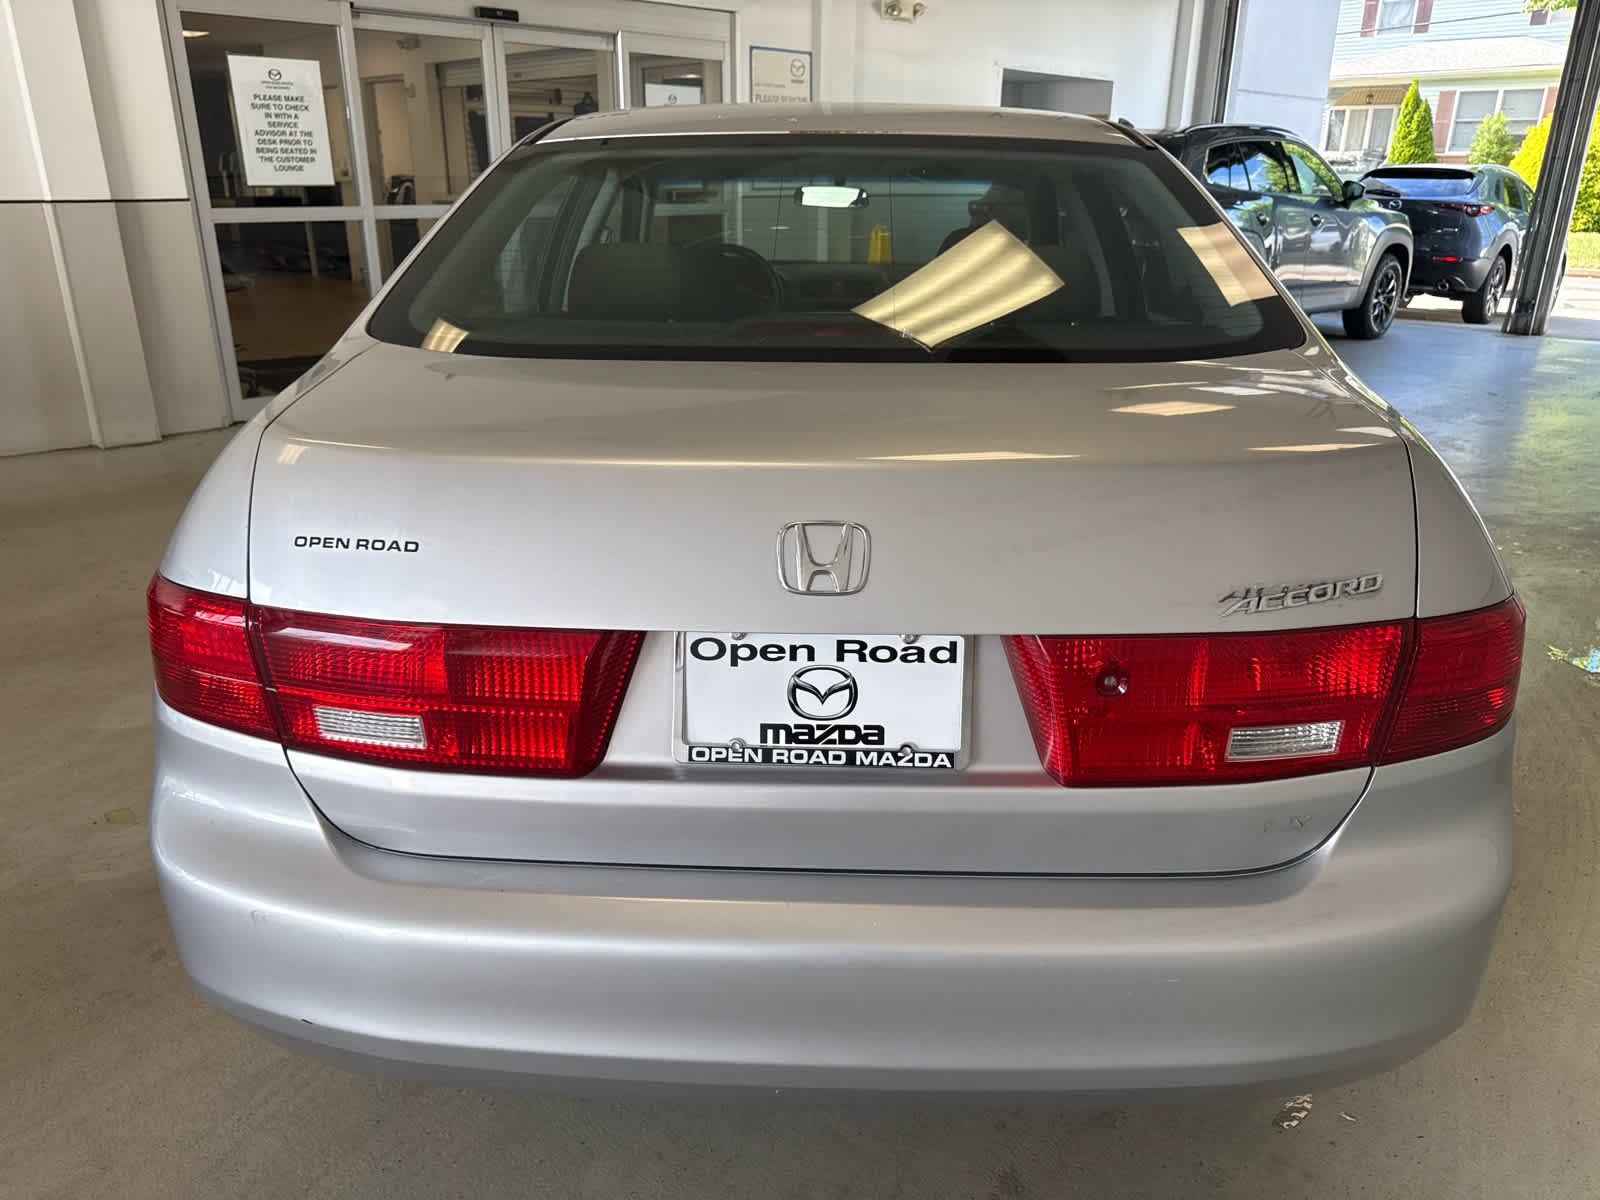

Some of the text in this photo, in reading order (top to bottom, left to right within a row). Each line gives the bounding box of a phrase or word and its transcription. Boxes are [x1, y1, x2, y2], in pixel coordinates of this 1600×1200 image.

[253, 93, 304, 103] PLEASE MAKE
[251, 103, 310, 112] SURE TO CHECK
[274, 112, 293, 120] WITH
[267, 121, 298, 129] SERVICE
[255, 129, 287, 137] ADVISOR
[299, 130, 313, 138] THE
[279, 138, 302, 146] PRIOR
[280, 147, 308, 155] SEATED
[259, 155, 315, 164] THE CUSTOMER
[273, 164, 304, 172] LOUNGE
[294, 536, 419, 552] OPEN ROAD
[1217, 572, 1383, 617] ACCORD
[690, 637, 958, 667] Open Road
[691, 746, 952, 768] OPEN ROAD MAZDA
